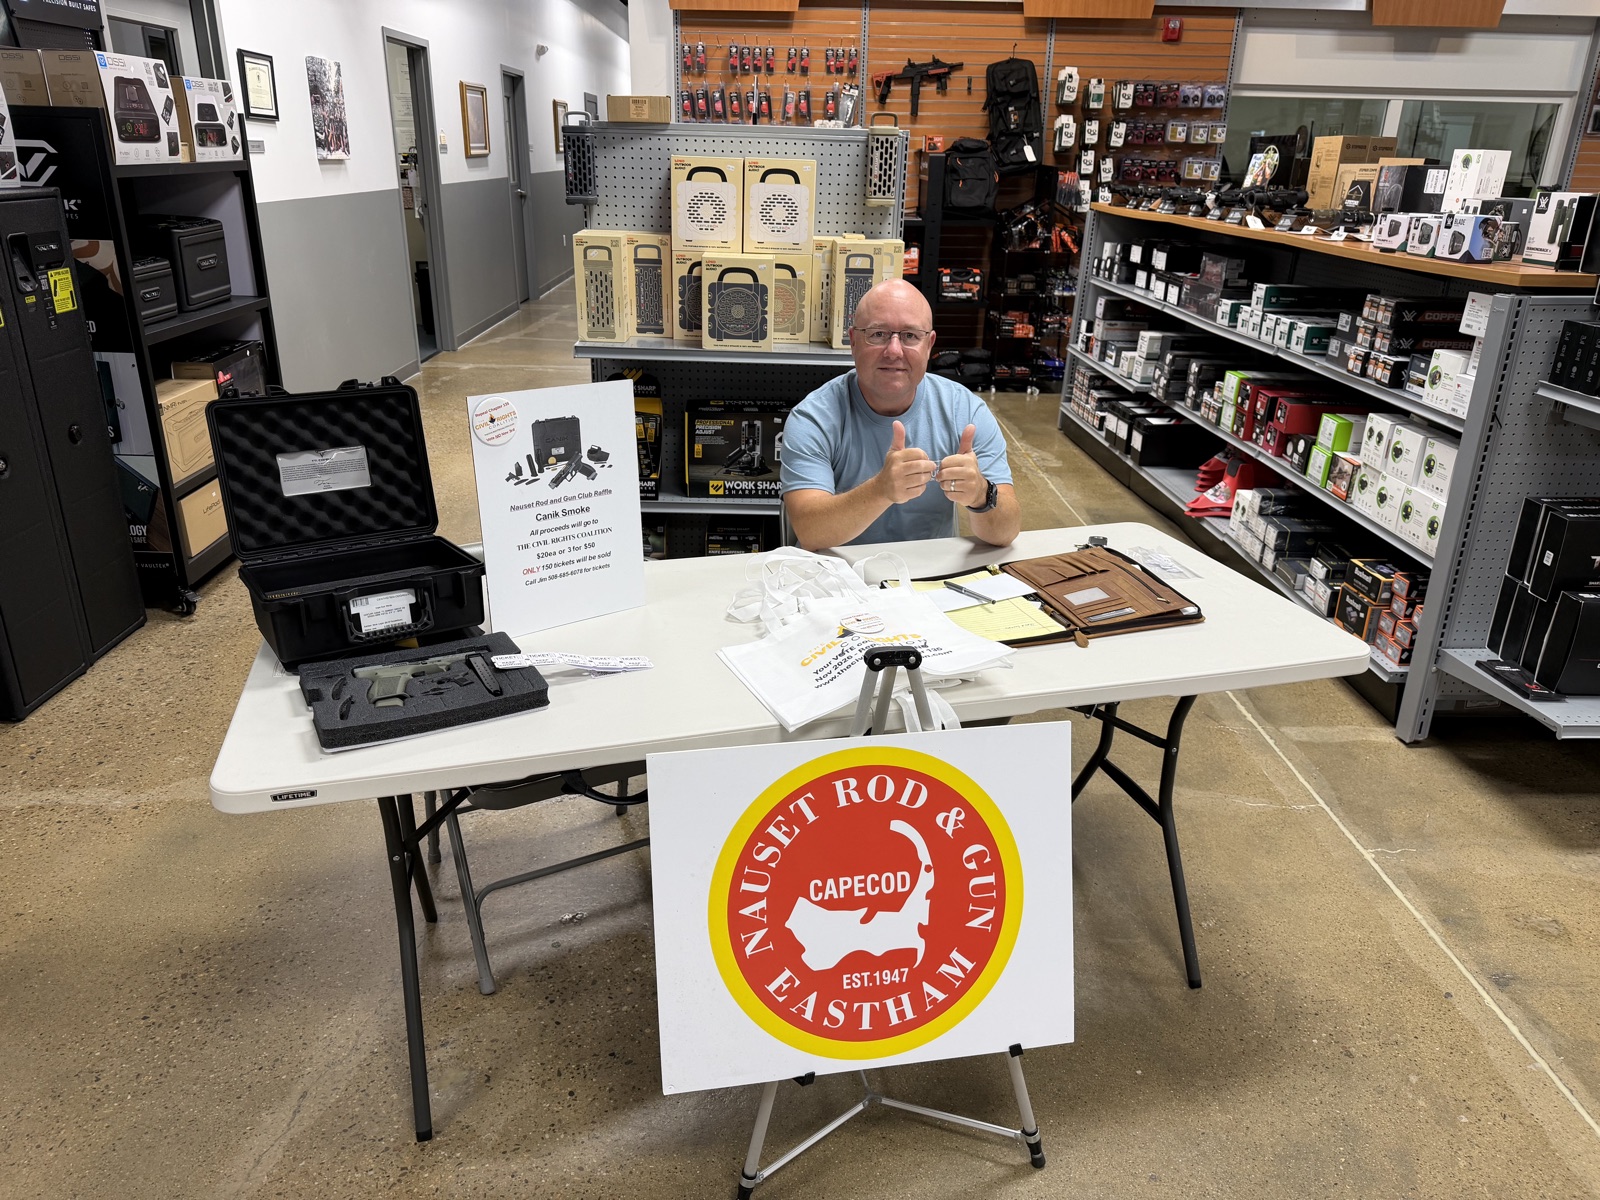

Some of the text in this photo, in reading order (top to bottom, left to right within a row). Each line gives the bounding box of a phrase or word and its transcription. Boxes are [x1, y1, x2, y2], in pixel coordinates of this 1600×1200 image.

[68, 1, 82, 9] BUILT
[83, 4, 96, 12] SAFES
[475, 410, 517, 430] CIVIL RIGHTS
[489, 416, 518, 430] COALITION
[724, 480, 783, 490] WORK SHAR
[510, 488, 612, 512] Nauset Rod and Gun Club Raffle
[536, 505, 591, 522] Canik Smoke
[540, 524, 570, 536] proceeds
[583, 520, 592, 528] go
[516, 526, 613, 552] THE CIVIL RIGHTS COALITION
[522, 566, 541, 576] ONLY
[542, 563, 552, 571] 150
[553, 559, 576, 568] tickets
[597, 551, 612, 560] sold
[536, 550, 557, 560] $20ea
[592, 563, 611, 572] tickets
[801, 640, 843, 667] CIVIL
[813, 660, 832, 676] Your
[815, 670, 832, 682] Nov
[832, 656, 852, 671] 2026
[276, 792, 312, 800] LIFETIME
[740, 774, 998, 959] NAUSET ROD & GUN
[809, 870, 911, 902] CAPECOD
[764, 947, 976, 1031] EASTHAM
[842, 968, 910, 990] EST.1947
